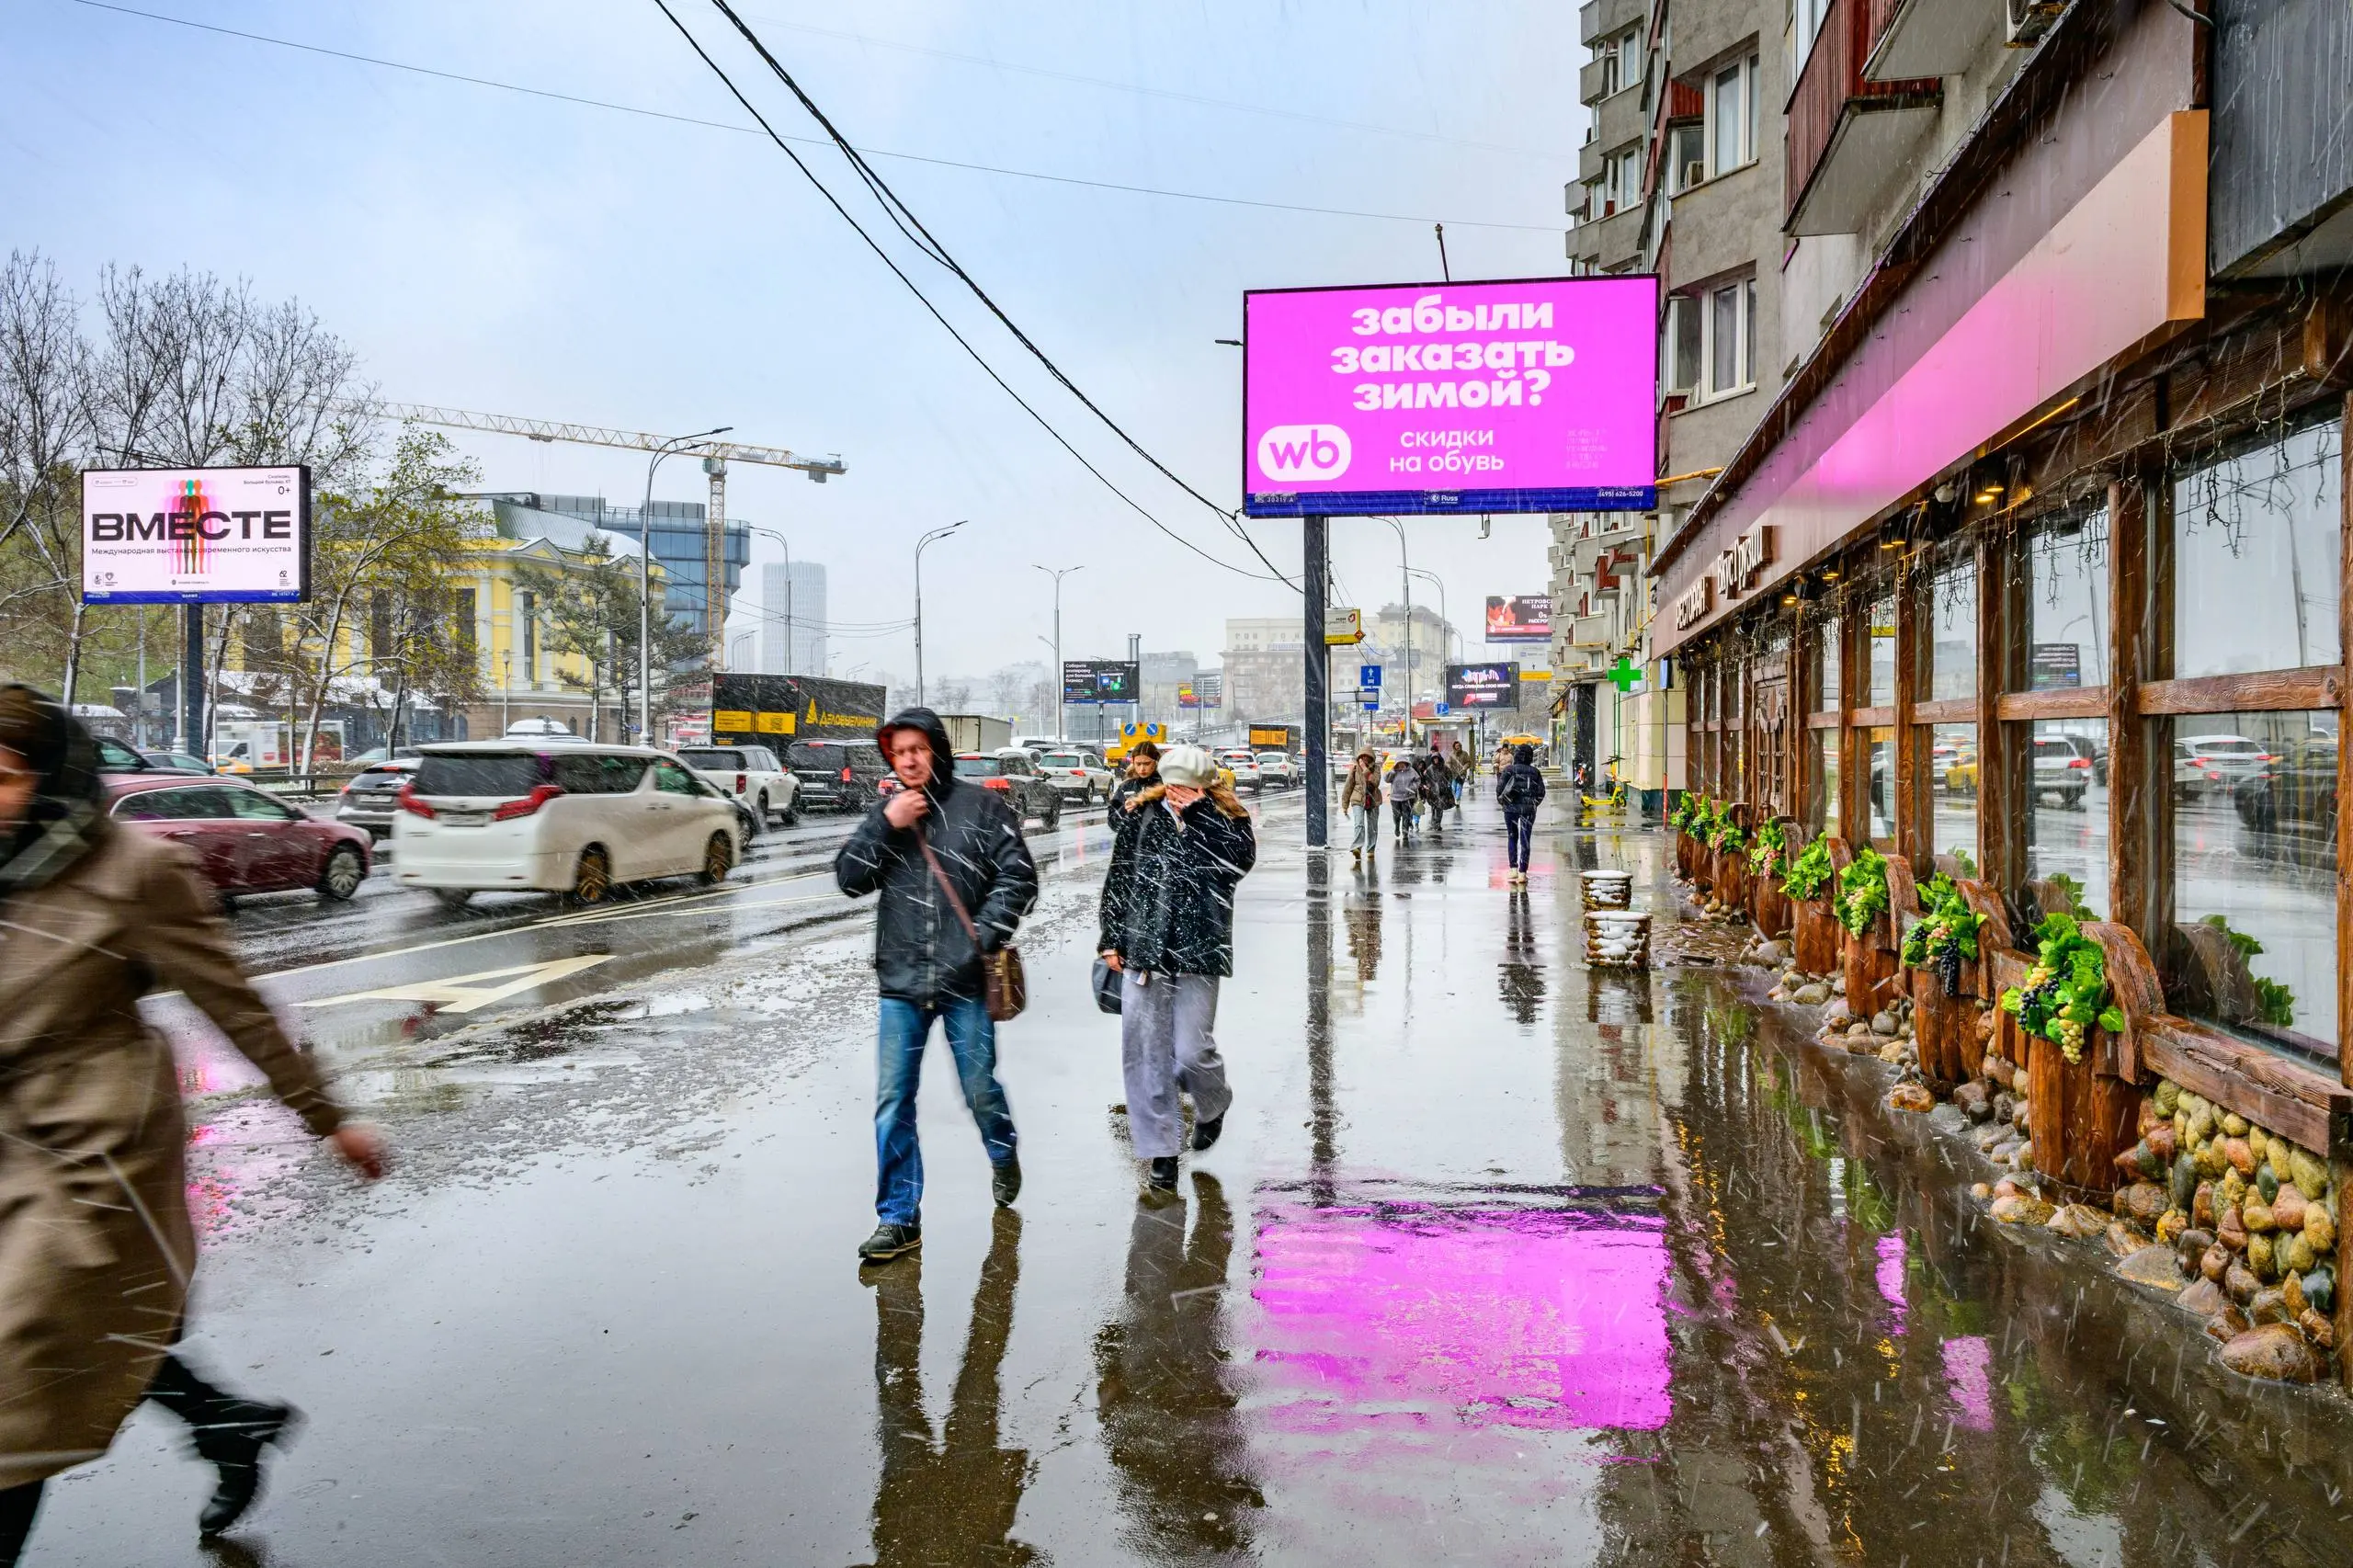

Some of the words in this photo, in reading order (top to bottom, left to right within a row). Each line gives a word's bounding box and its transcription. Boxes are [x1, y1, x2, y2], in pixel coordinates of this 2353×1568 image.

[1351, 293, 1553, 335] забыли
[1331, 339, 1575, 374] заказать
[1352, 369, 1552, 411] зимой?
[1268, 429, 1340, 470] wb
[1400, 429, 1495, 449] скидки
[1390, 455, 1425, 472] на
[1428, 451, 1505, 477] обувь
[278, 485, 291, 495] 0+
[92, 510, 291, 541] ВМЕСТЕ
[91, 547, 155, 557] Международная
[252, 545, 291, 554] искусства
